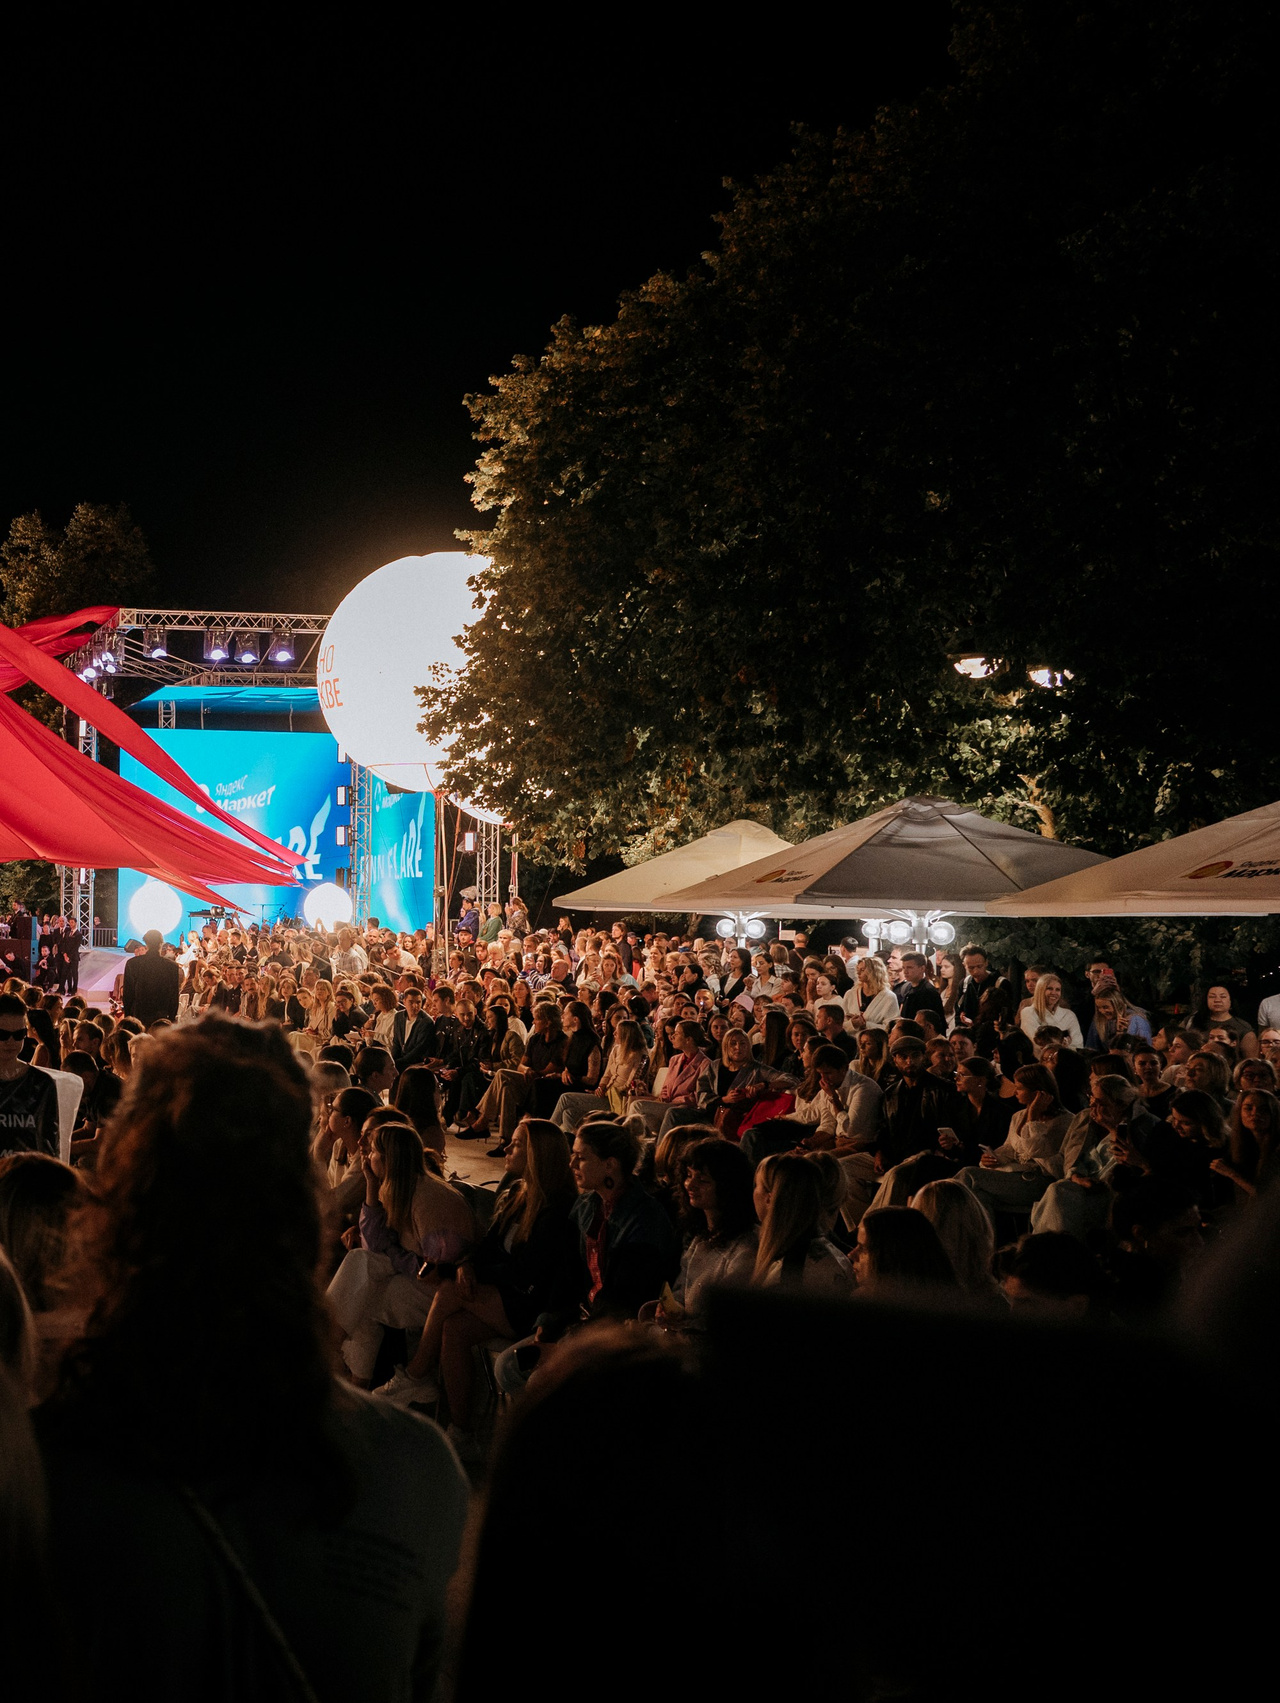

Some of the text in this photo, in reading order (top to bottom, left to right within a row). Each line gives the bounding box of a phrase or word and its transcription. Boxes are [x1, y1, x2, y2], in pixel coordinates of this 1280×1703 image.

[319, 644, 335, 673] НО
[320, 677, 344, 710] КВЕ
[215, 774, 248, 797] Яндекс
